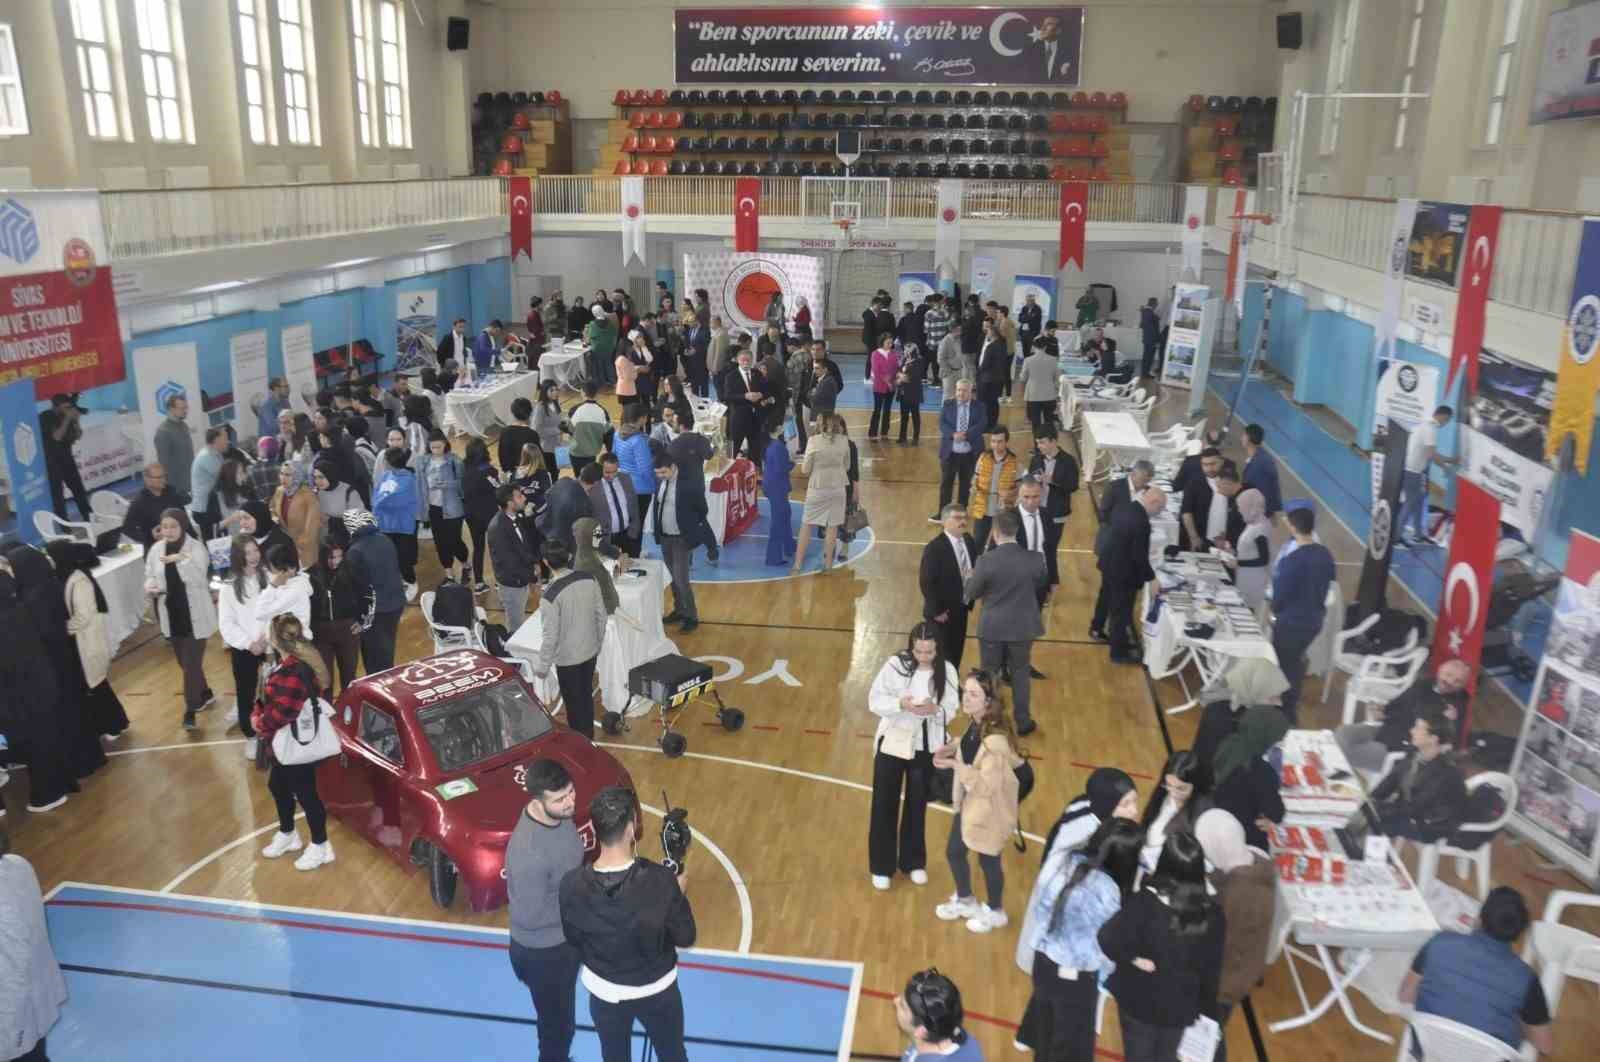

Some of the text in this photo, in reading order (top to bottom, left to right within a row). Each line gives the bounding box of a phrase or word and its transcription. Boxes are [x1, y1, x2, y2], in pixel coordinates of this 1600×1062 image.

[740, 24, 848, 45] sporcunun
[904, 21, 958, 46] çevik
[960, 25, 983, 41] ve
[690, 53, 798, 72] ahlaklısını
[11, 284, 45, 308] SİVAS
